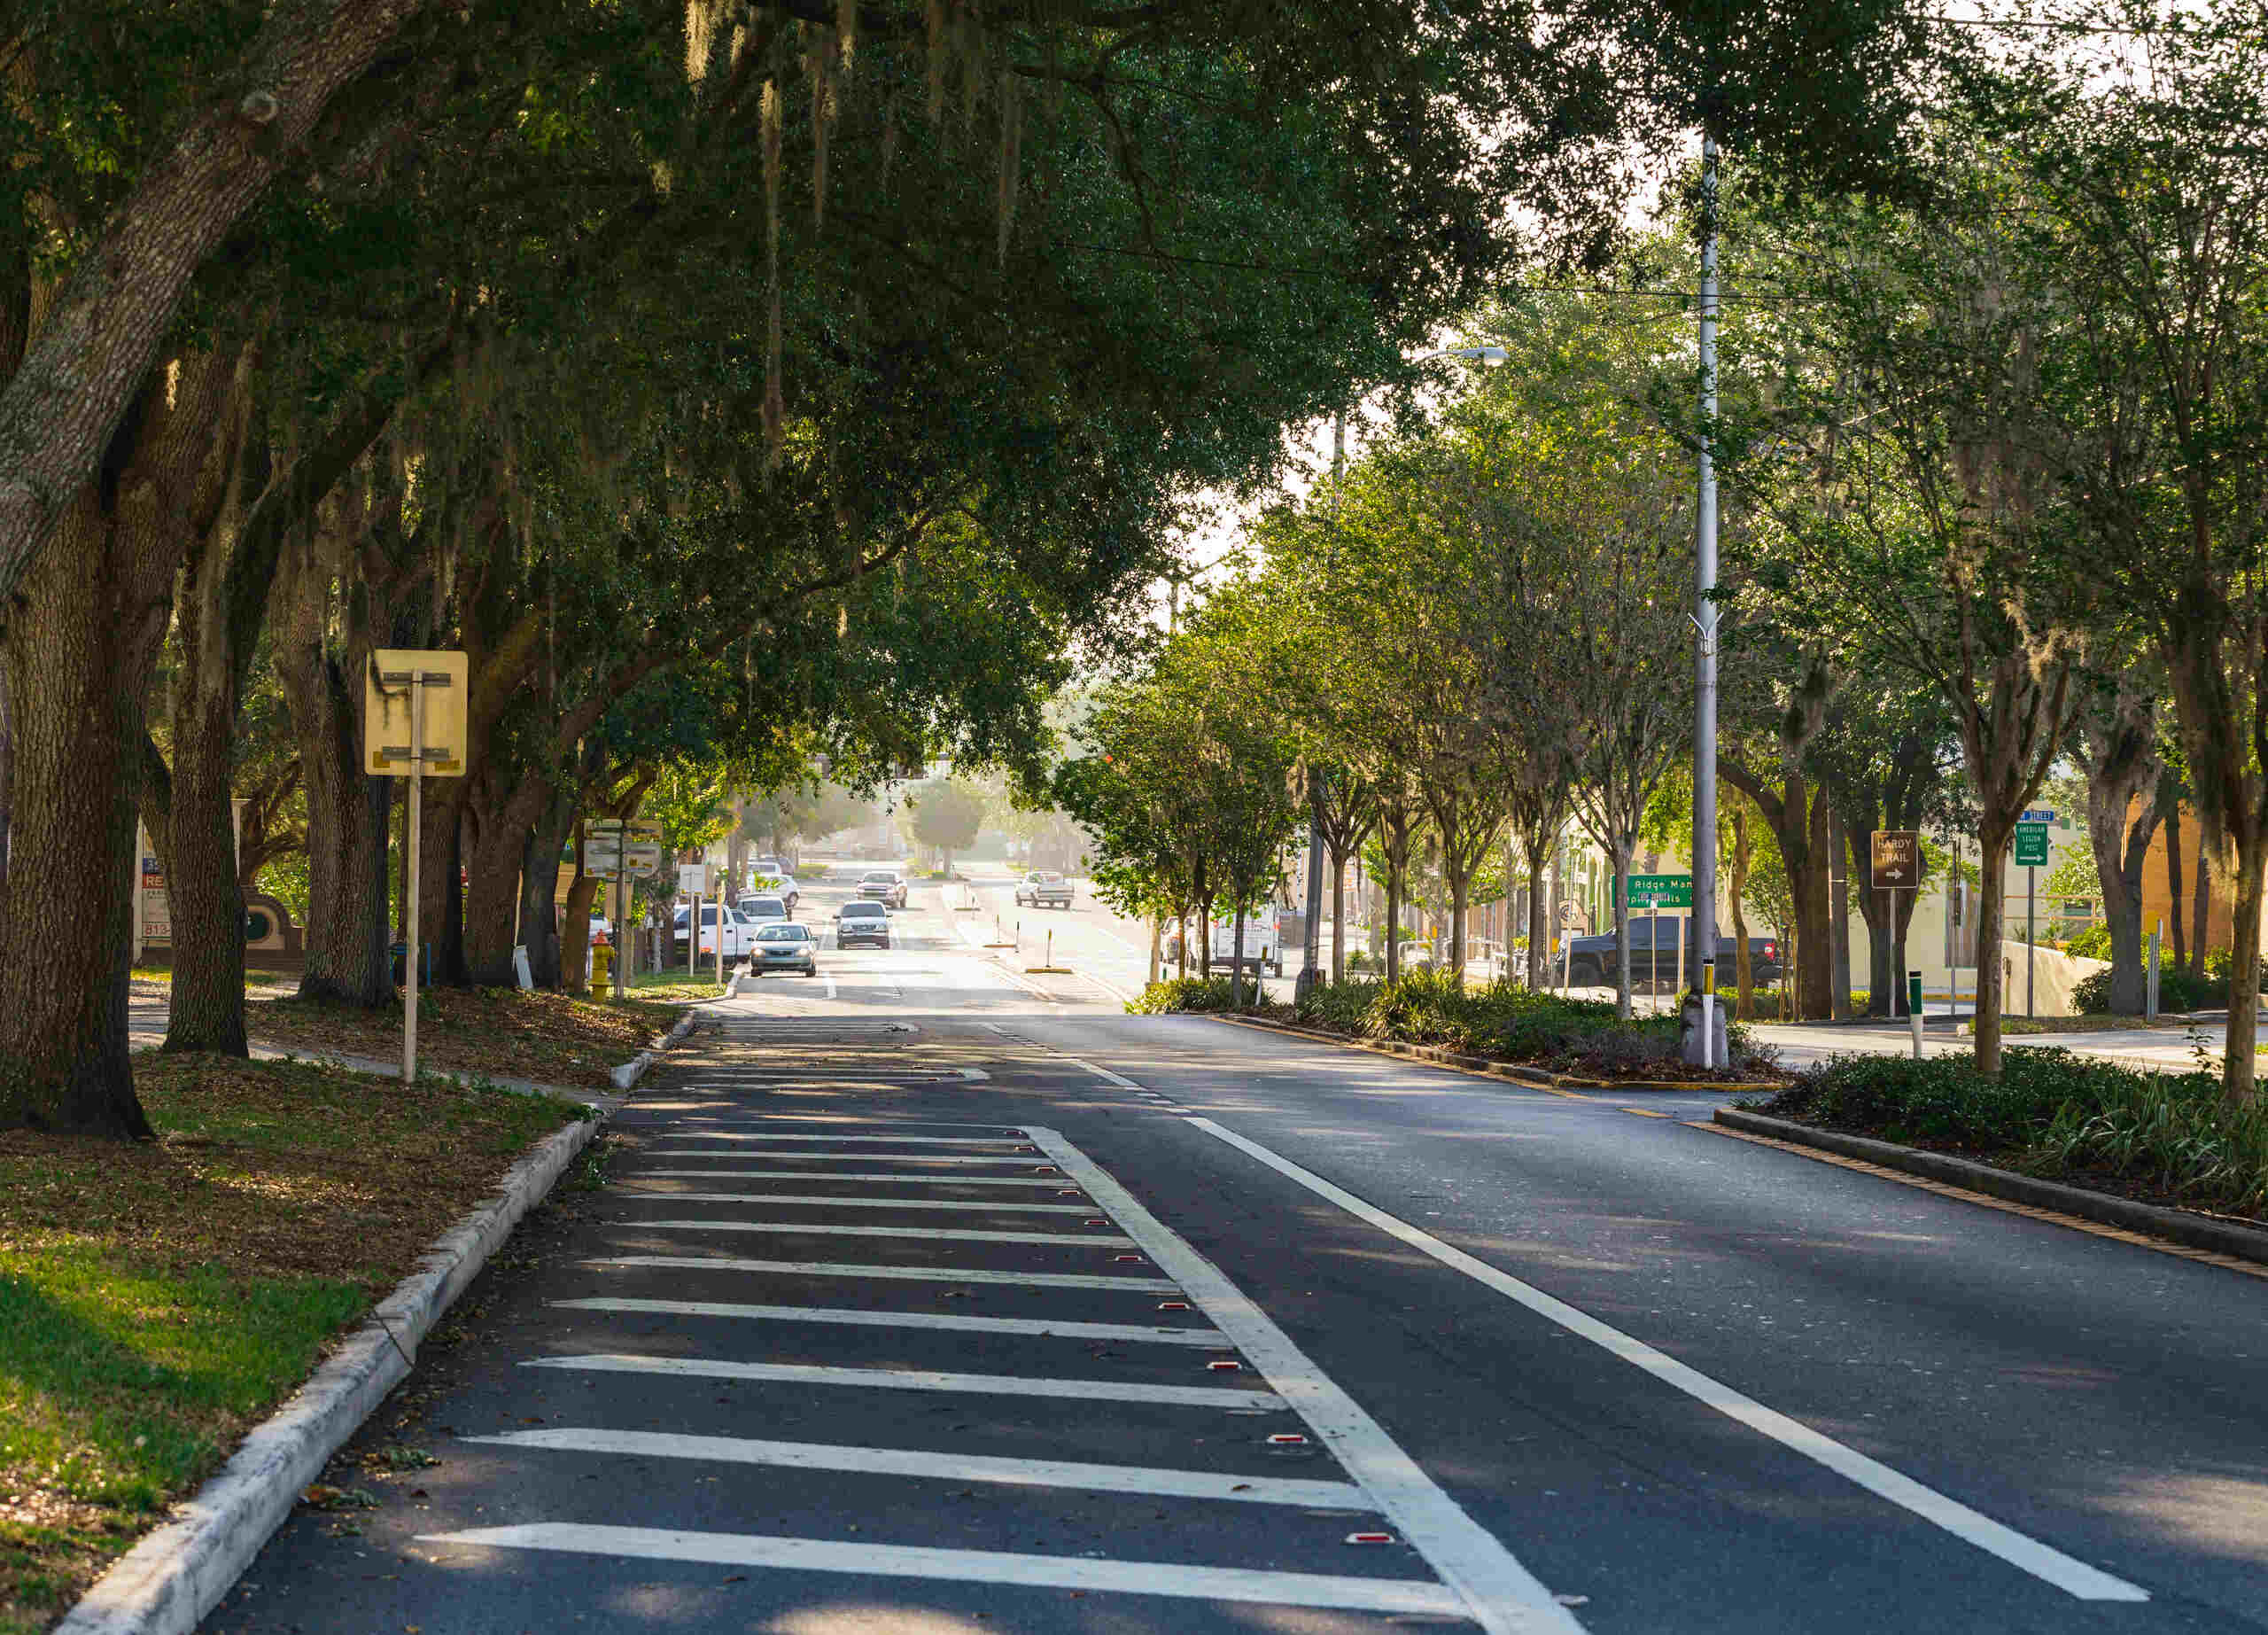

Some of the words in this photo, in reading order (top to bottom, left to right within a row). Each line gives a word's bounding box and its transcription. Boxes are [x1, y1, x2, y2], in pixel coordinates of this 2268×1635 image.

[1878, 837, 1912, 849] HARDY
[1880, 853, 1910, 863] TRAIL
[1635, 879, 1666, 891] Ridge
